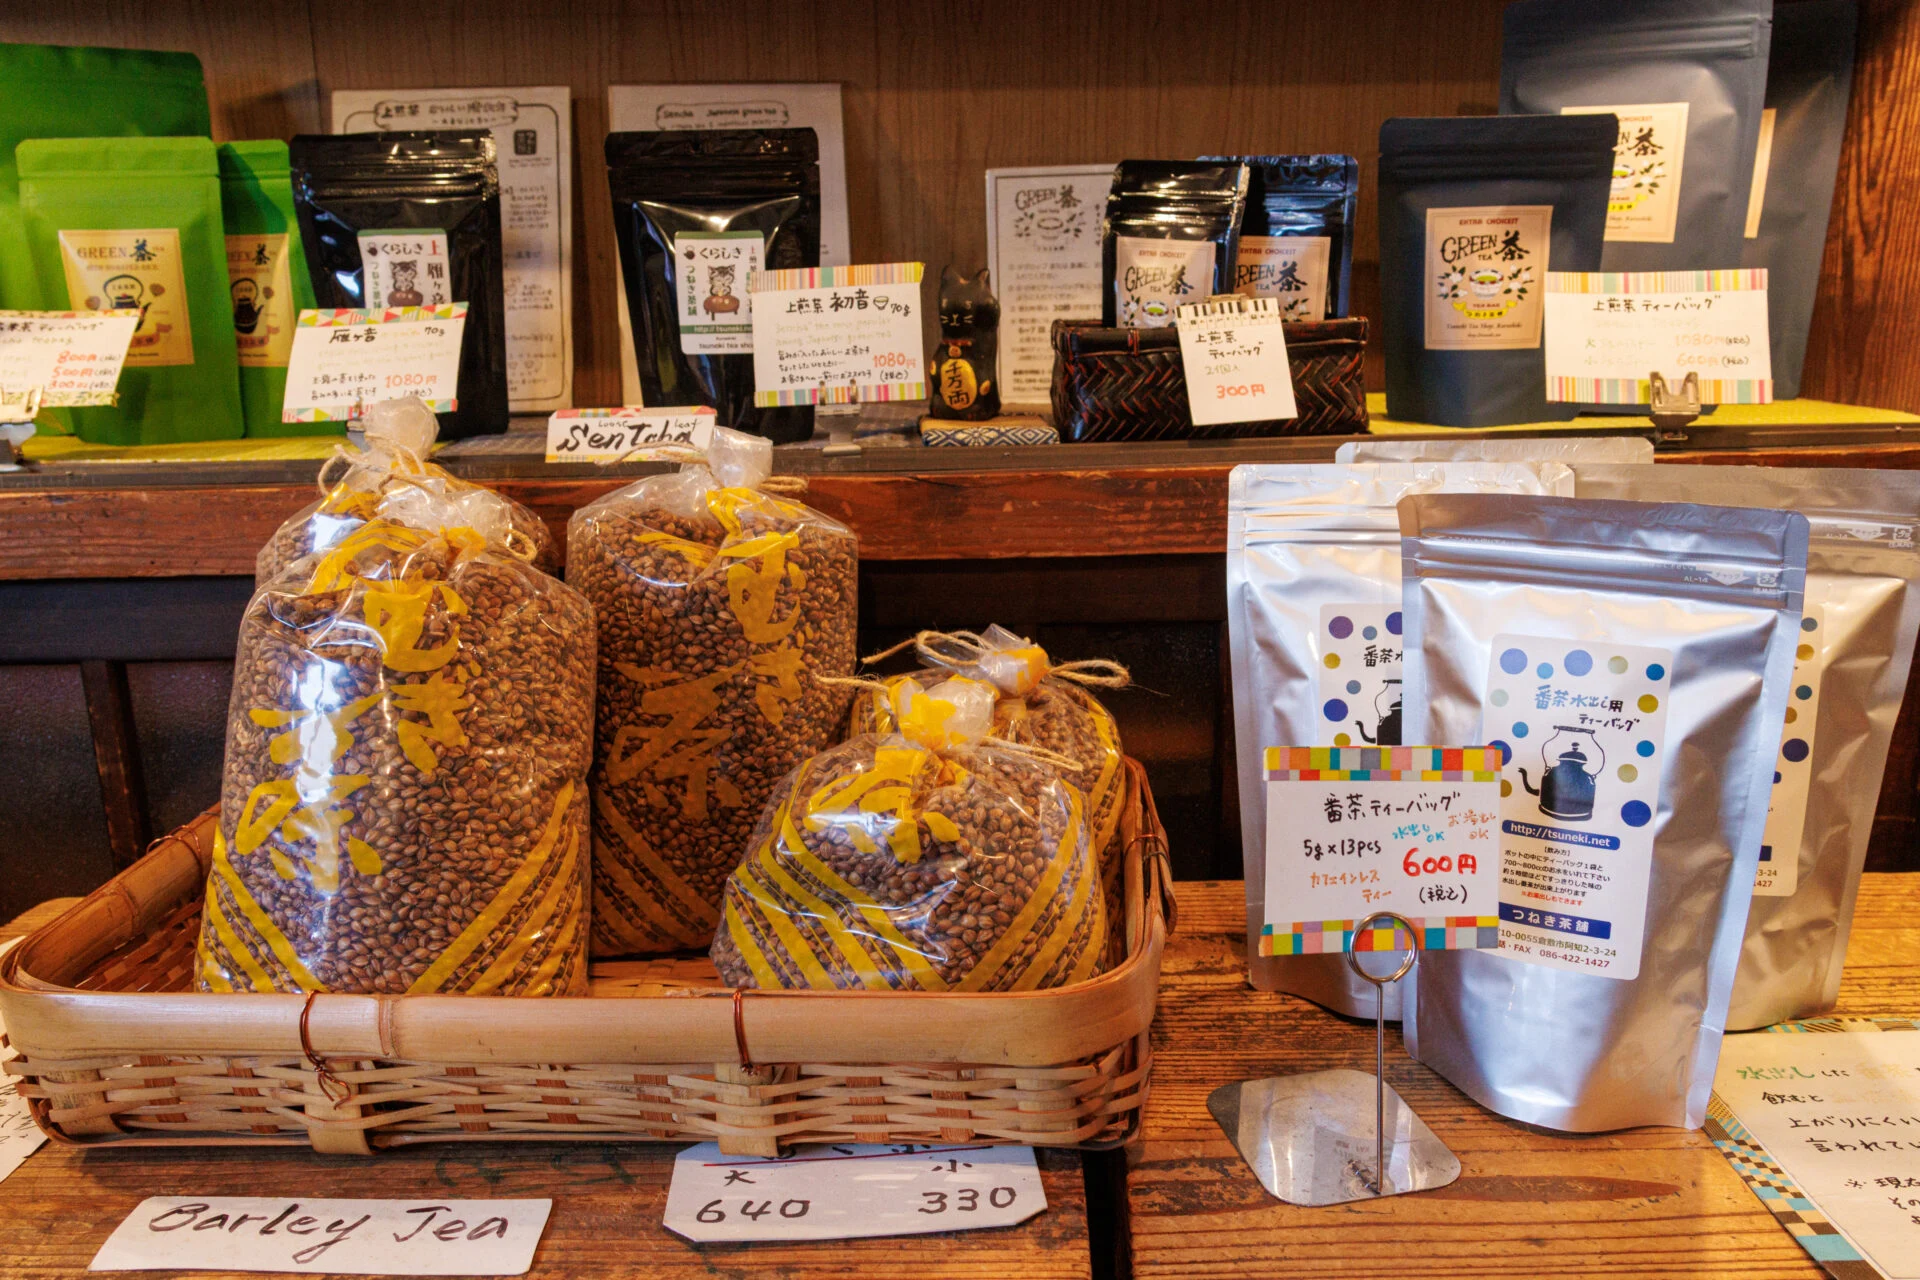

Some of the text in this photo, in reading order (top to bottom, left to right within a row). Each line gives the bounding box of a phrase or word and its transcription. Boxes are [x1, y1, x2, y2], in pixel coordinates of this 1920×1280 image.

[1627, 127, 1664, 157] 茶
[1015, 188, 1057, 211] GREEN
[1055, 184, 1082, 209] 茶
[77, 246, 127, 259] GREEN
[129, 239, 157, 262] 茶
[381, 243, 424, 255] くらしき
[699, 247, 742, 259] くらしき
[1440, 234, 1498, 264] GREEN
[1494, 229, 1531, 262] 茶
[1125, 265, 1168, 292] GREEN
[1164, 264, 1195, 295] 茶
[1236, 264, 1276, 289] REEN
[1272, 260, 1308, 292] 茶
[829, 288, 870, 312] 初音
[873, 352, 917, 369] 1080円
[385, 373, 438, 389] 1080円
[945, 361, 970, 406] 千万両
[1216, 383, 1265, 400] 300円
[1535, 684, 1624, 713] 番茶水出し用
[1578, 713, 1641, 732] ティーバッグ
[1324, 791, 1461, 824] 番茶ティーバッグ
[1510, 823, 1611, 848] http://tsuneki.net
[1402, 847, 1477, 877] 600円
[1311, 869, 1380, 888] カフェインレス
[1362, 889, 1392, 903] ティー
[1512, 909, 1590, 934] つねき茶舗
[1499, 927, 1618, 958] 10-0055倉敷市阿知2-3-24
[1539, 949, 1611, 968] 086-422-1427
[1762, 1092, 1824, 1105] 飲むと
[696, 1187, 1016, 1224] 640 330
[149, 1203, 509, 1264] Barley Tea
